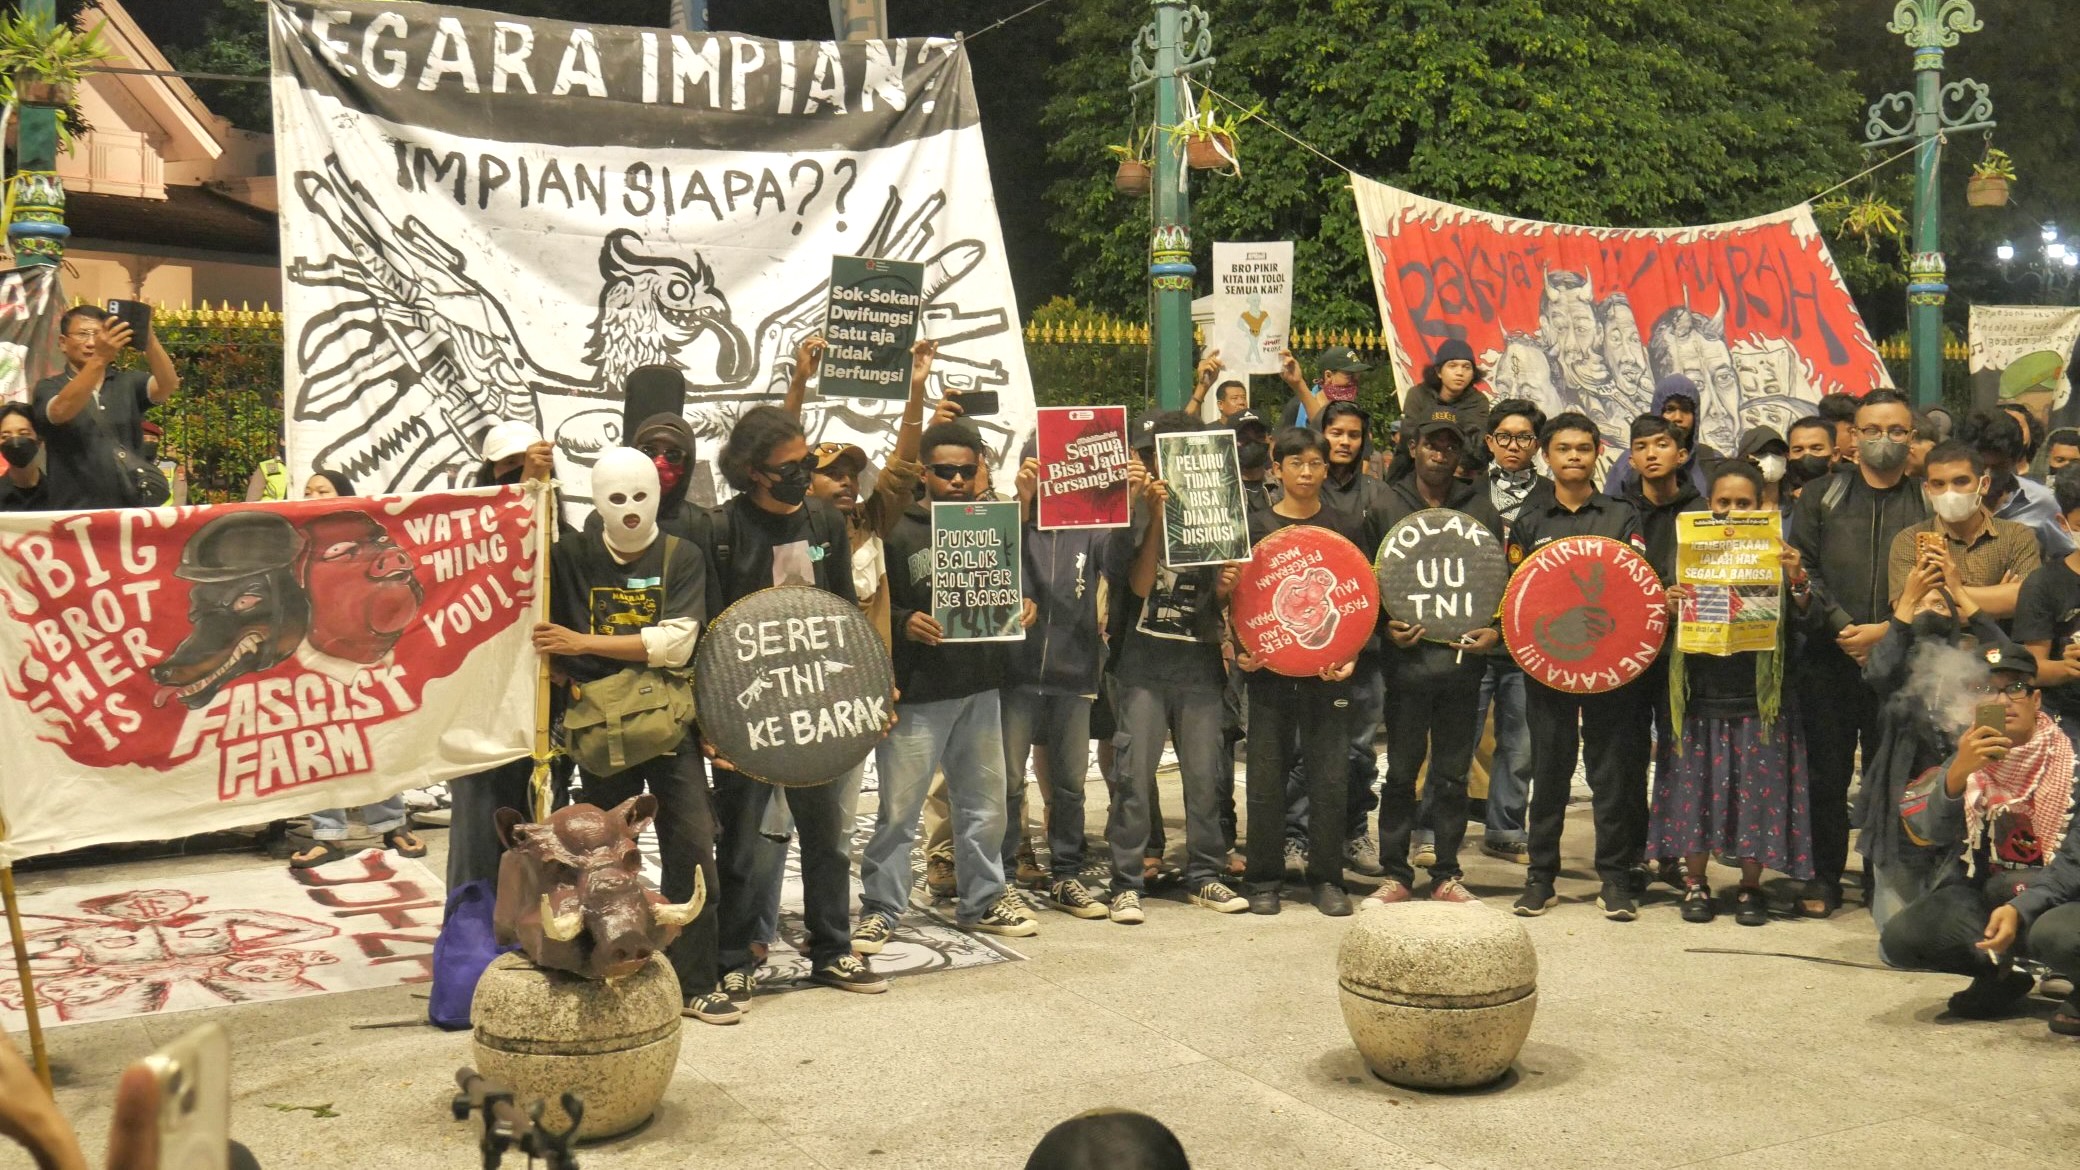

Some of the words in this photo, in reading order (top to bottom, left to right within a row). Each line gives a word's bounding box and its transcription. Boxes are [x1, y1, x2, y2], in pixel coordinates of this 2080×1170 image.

[640, 32, 958, 115] IMPIAN?
[395, 140, 606, 216] IMPIAN
[623, 158, 857, 235] SIAPA??
[1222, 275, 1243, 284] KITA
[1246, 275, 1259, 284] INI
[1261, 274, 1285, 283] TOLOL
[1232, 264, 1251, 273] BRO
[1254, 263, 1278, 272] PIKIR
[832, 285, 919, 306] Sok-Sokan
[1225, 285, 1258, 295] SEMUA
[1260, 285, 1284, 295] KAH?
[830, 305, 914, 328] Dwifungsi
[828, 325, 867, 341] Satu
[870, 329, 895, 346] aja
[827, 344, 873, 361] Tidak
[823, 363, 904, 385] Berfungsi
[1065, 438, 1123, 461] Semua
[1048, 461, 1086, 481] Bisa
[1089, 448, 1127, 471] Jadi
[1175, 453, 1224, 472] PELURU
[1040, 468, 1128, 497] Tersangka
[1184, 472, 1221, 489] TIDAK
[1190, 489, 1220, 507] BISA
[404, 504, 499, 547] WATC
[1183, 508, 1230, 527] DIAJAK
[936, 528, 1001, 548] PUKUL
[1183, 525, 1235, 545] DISKUSI
[1384, 516, 1490, 559] TOLAK
[21, 508, 157, 600] BIG
[936, 550, 998, 569] BALIK
[936, 569, 1012, 588] MILITER
[1417, 558, 1465, 588] UU
[1685, 567, 1727, 579] SEGALA
[1729, 568, 1774, 580] BANGSA
[1335, 577, 1360, 598] KAU
[1536, 539, 1604, 572] KIRIM
[1613, 547, 1661, 596] FASIS
[1645, 603, 1666, 634] KE
[936, 591, 960, 608] KE
[966, 589, 1019, 607] BARAK
[1408, 592, 1472, 620] TNI
[34, 579, 161, 663] BROT
[423, 575, 514, 648] YOU!
[734, 615, 847, 662] SERET
[86, 693, 142, 751] IS
[169, 665, 418, 760] FASCIST
[747, 716, 786, 751] KE
[789, 695, 889, 745] BARAK
[219, 722, 374, 801] FARM
